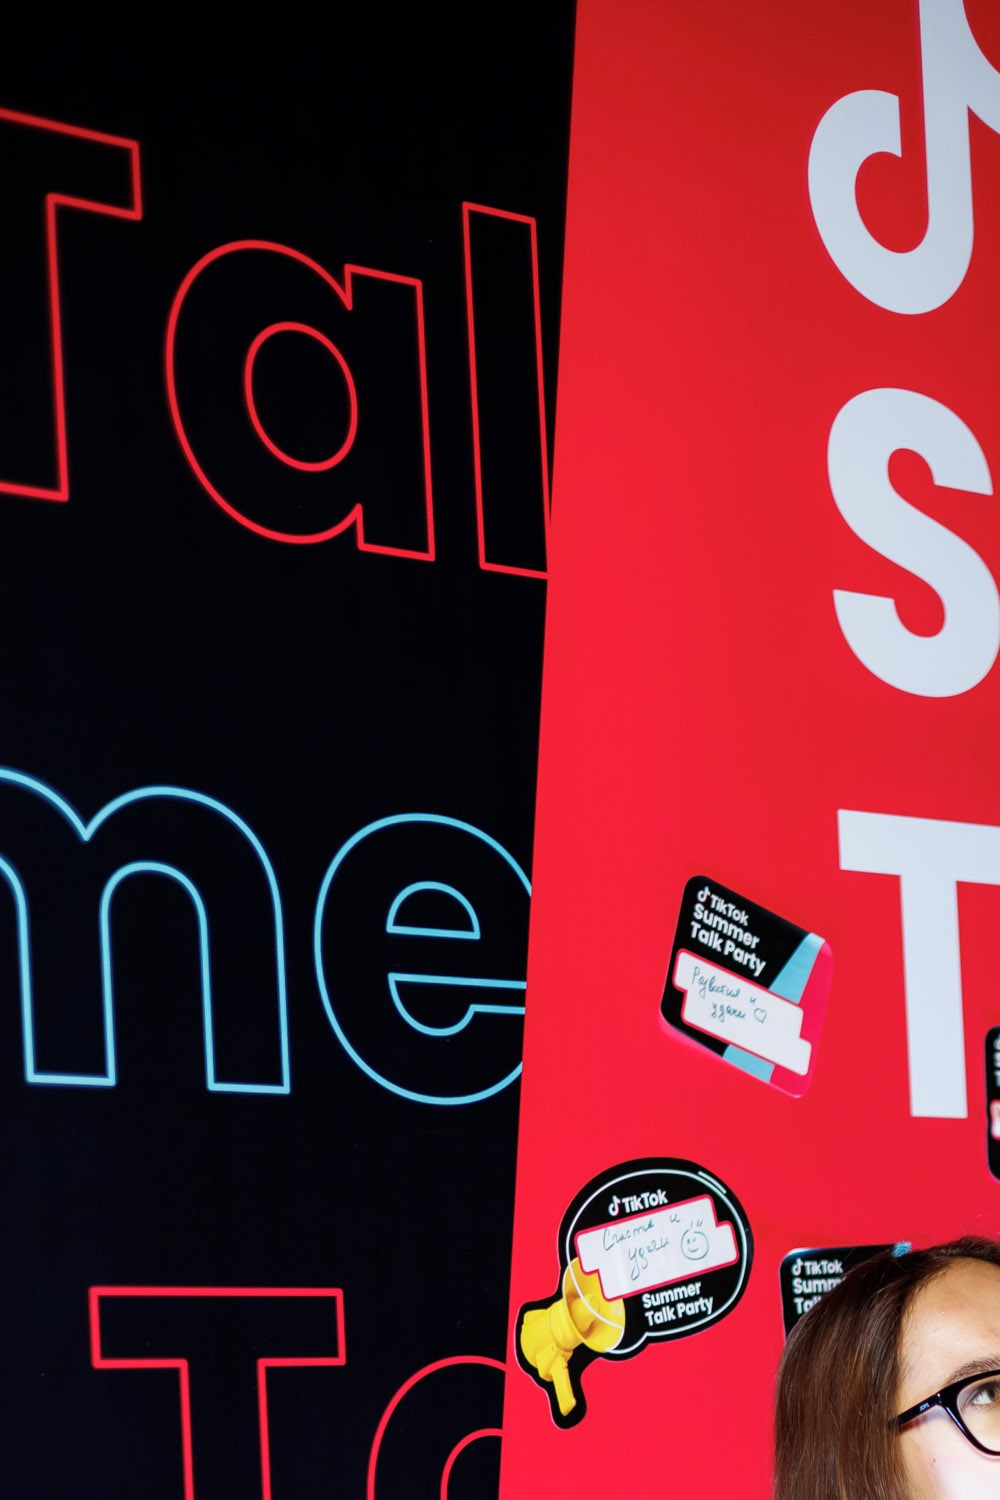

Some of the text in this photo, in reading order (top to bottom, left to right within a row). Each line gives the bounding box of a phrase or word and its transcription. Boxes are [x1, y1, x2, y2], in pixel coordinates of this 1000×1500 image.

[710, 893, 749, 926] TikTok
[693, 902, 760, 949] Summer
[690, 920, 767, 977] Talk Party
[620, 1188, 669, 1214] TikTok
[803, 1258, 844, 1276] TikTok
[641, 1280, 702, 1309] Summer
[644, 1296, 714, 1327] Talk Party
